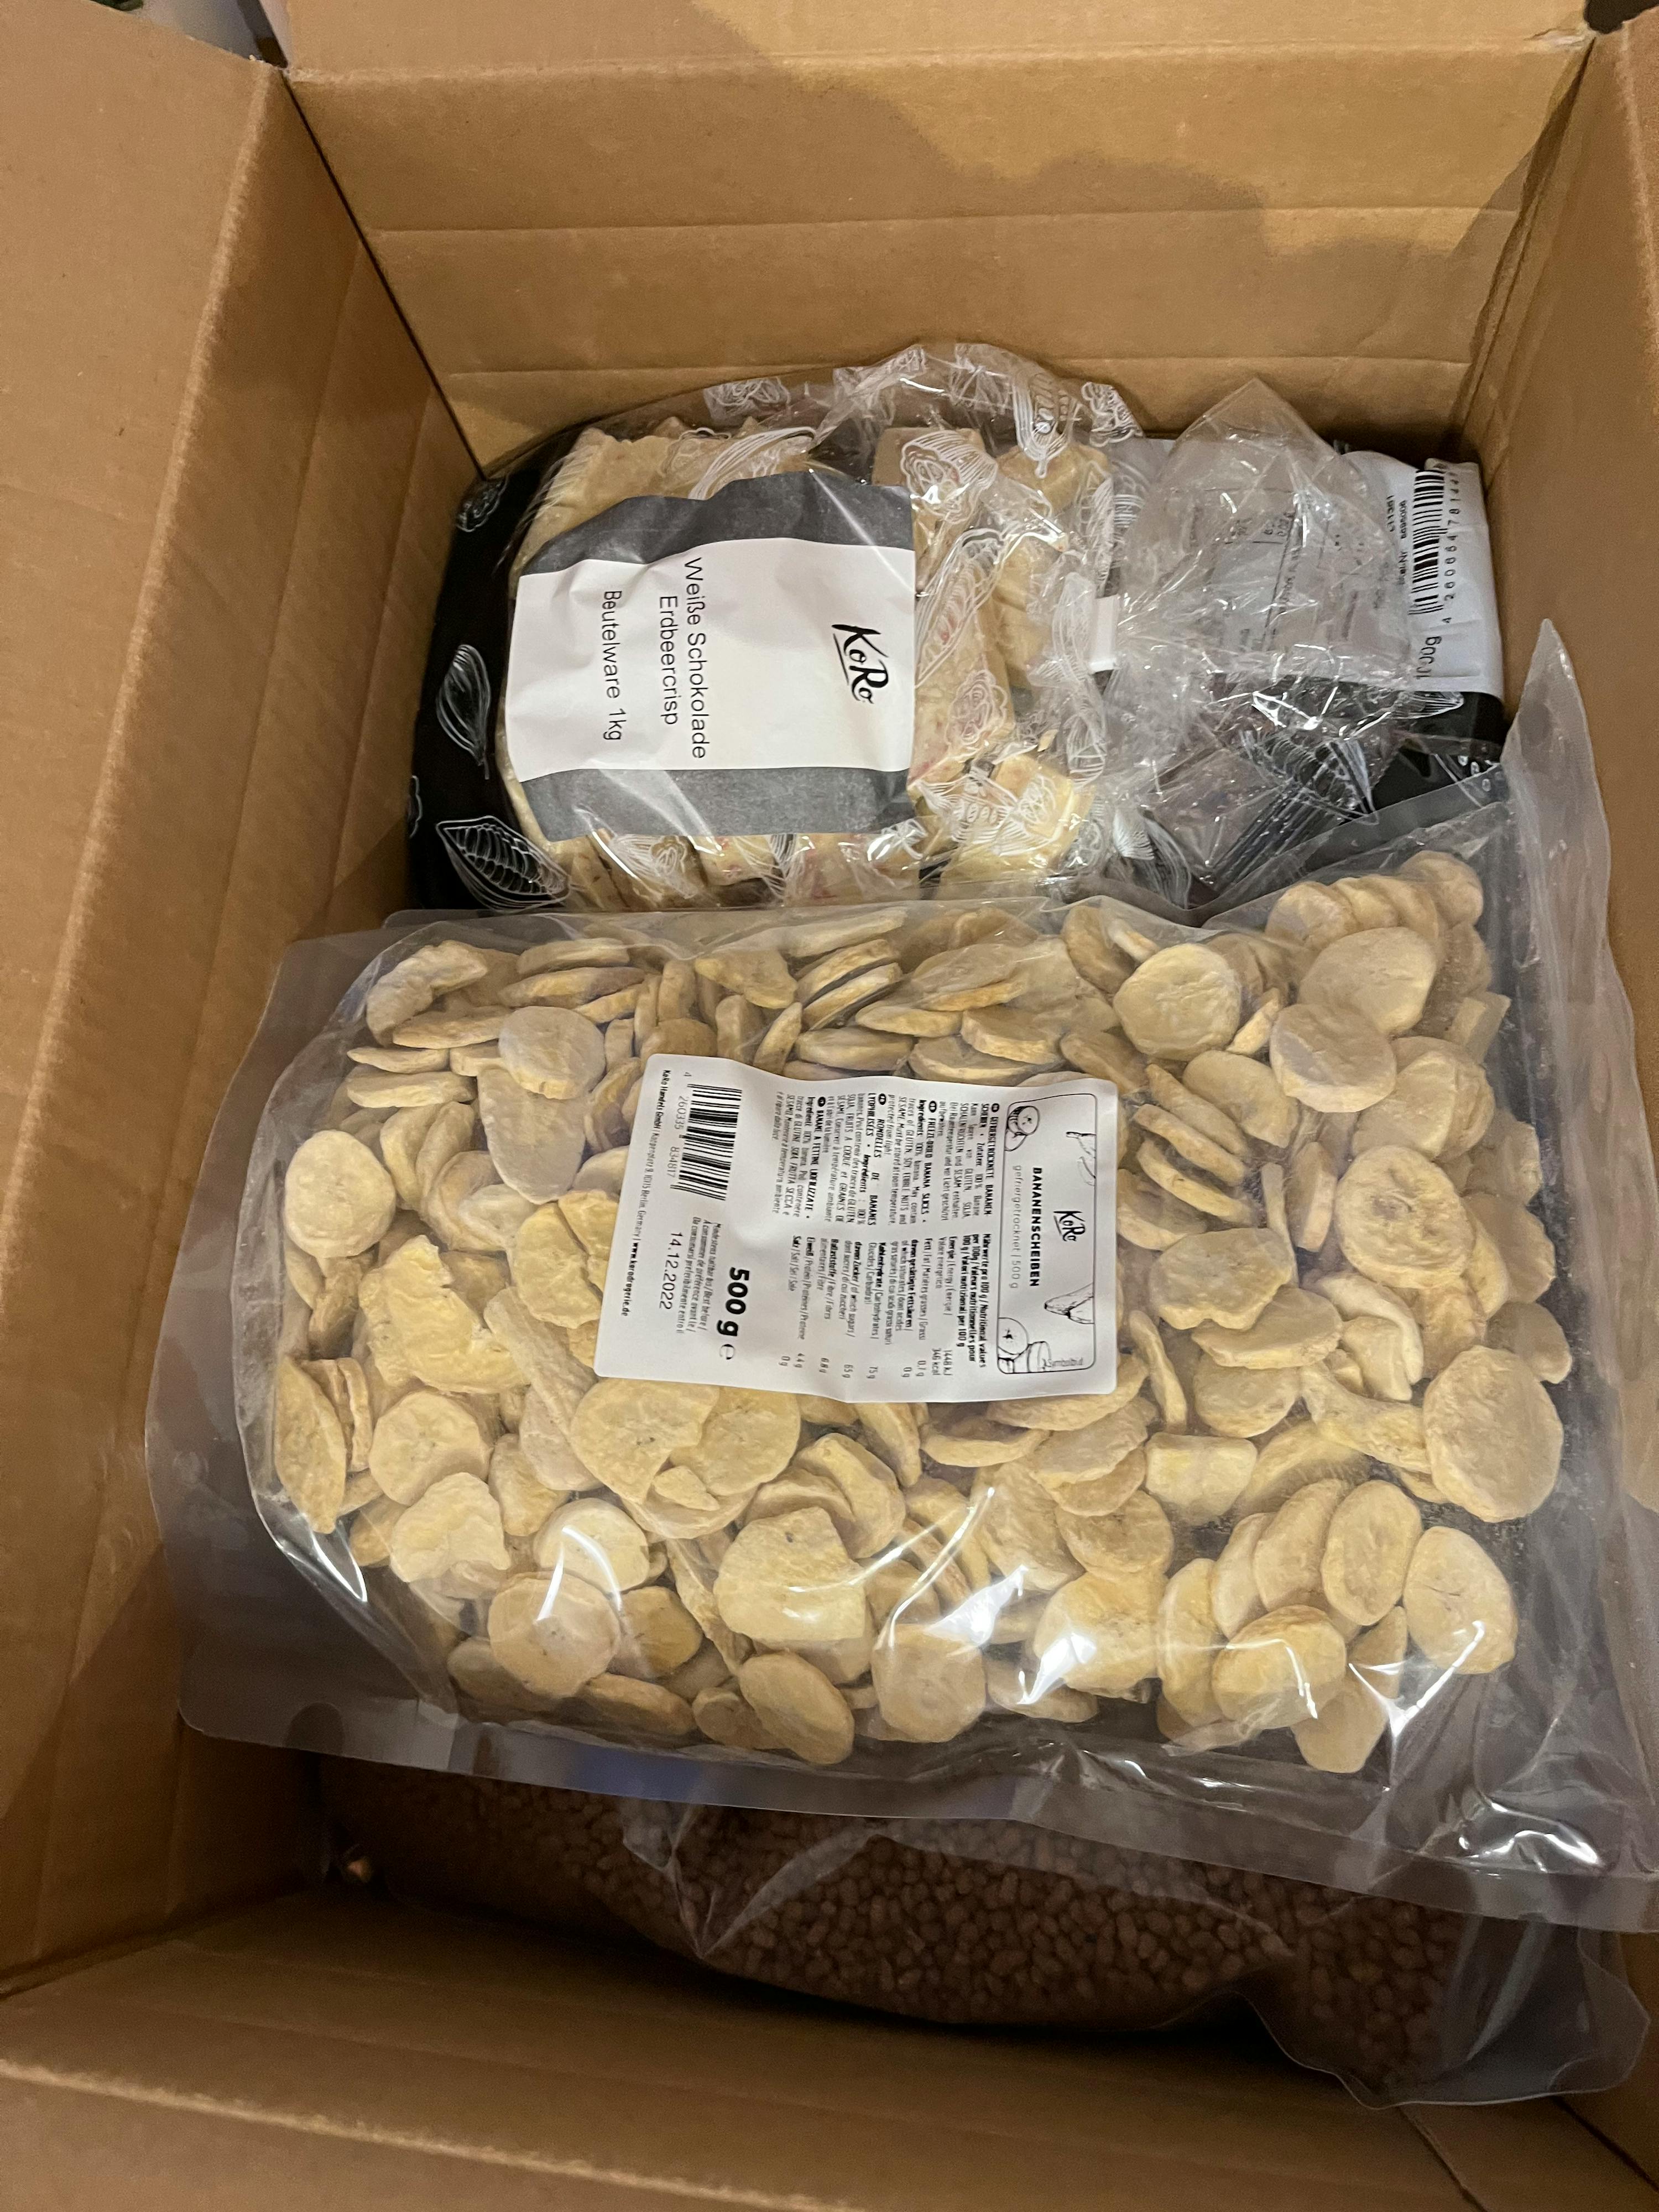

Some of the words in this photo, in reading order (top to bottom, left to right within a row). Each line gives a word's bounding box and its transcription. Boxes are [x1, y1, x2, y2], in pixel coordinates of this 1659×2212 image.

[684, 557, 705, 625] Weiße
[602, 591, 622, 698] Beutelware
[660, 596, 681, 725] Erdbeercrisp
[832, 624, 888, 705] KoRo
[603, 708, 627, 741] 1kg
[688, 633, 709, 759] Schokolade
[674, 1096, 688, 1129] 260335
[1010, 1165, 1024, 1251] gefriergetrocknet
[1029, 1167, 1042, 1287] BANANENSCHEIBEN
[1053, 1211, 1087, 1241] KoRo
[659, 1232, 683, 1310] 14.12.2022
[726, 1267, 749, 1314] 500
[971, 1266, 979, 1290] Valeurs
[980, 1269, 989, 1280] pro
[717, 1319, 738, 1336] g
[979, 1305, 988, 1341] Nutritional
